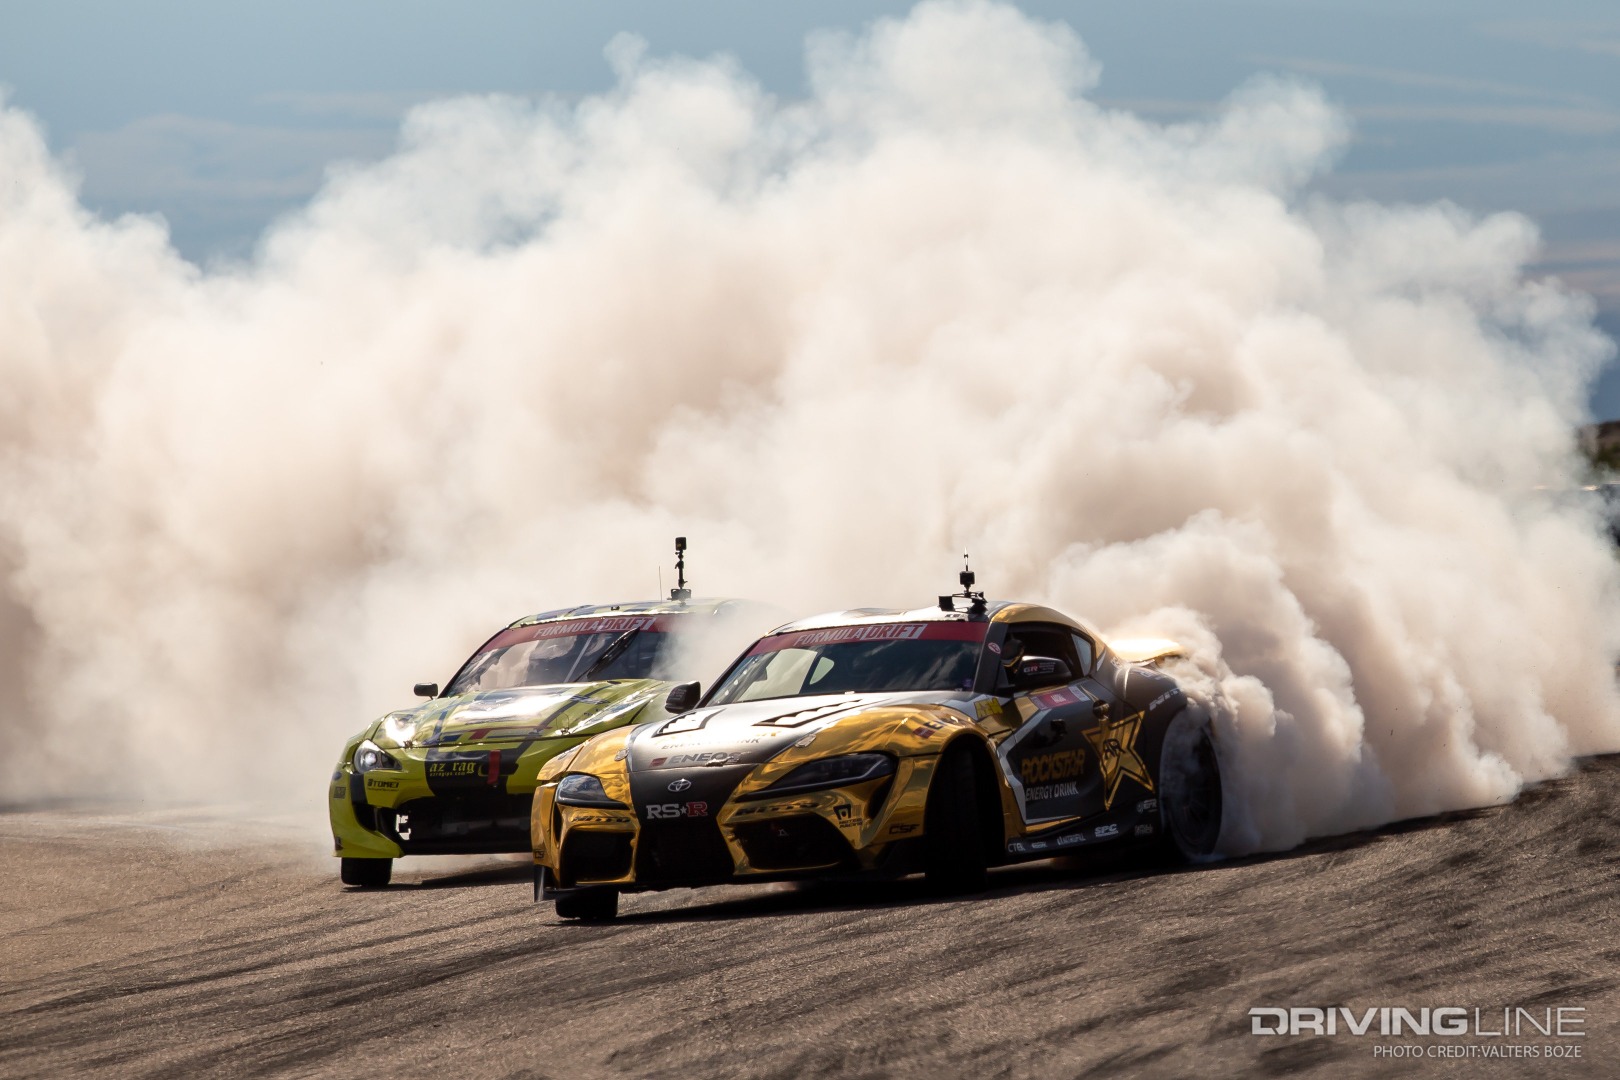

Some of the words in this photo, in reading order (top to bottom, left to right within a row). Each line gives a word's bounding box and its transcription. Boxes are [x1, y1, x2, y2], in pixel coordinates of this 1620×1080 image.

[533, 621, 600, 638] FORMULA
[598, 616, 656, 631] DRIFT
[793, 627, 861, 646] FORMULA
[860, 623, 928, 639] DRIFT
[669, 751, 741, 764] ENEOS
[1021, 748, 1085, 783] ROCKSTAR
[430, 763, 446, 772] az
[452, 761, 476, 773] rag
[1025, 784, 1054, 800] ENERGY
[1054, 781, 1079, 798] DRINK
[888, 823, 920, 835] CSF
[1095, 824, 1118, 834] SPC
